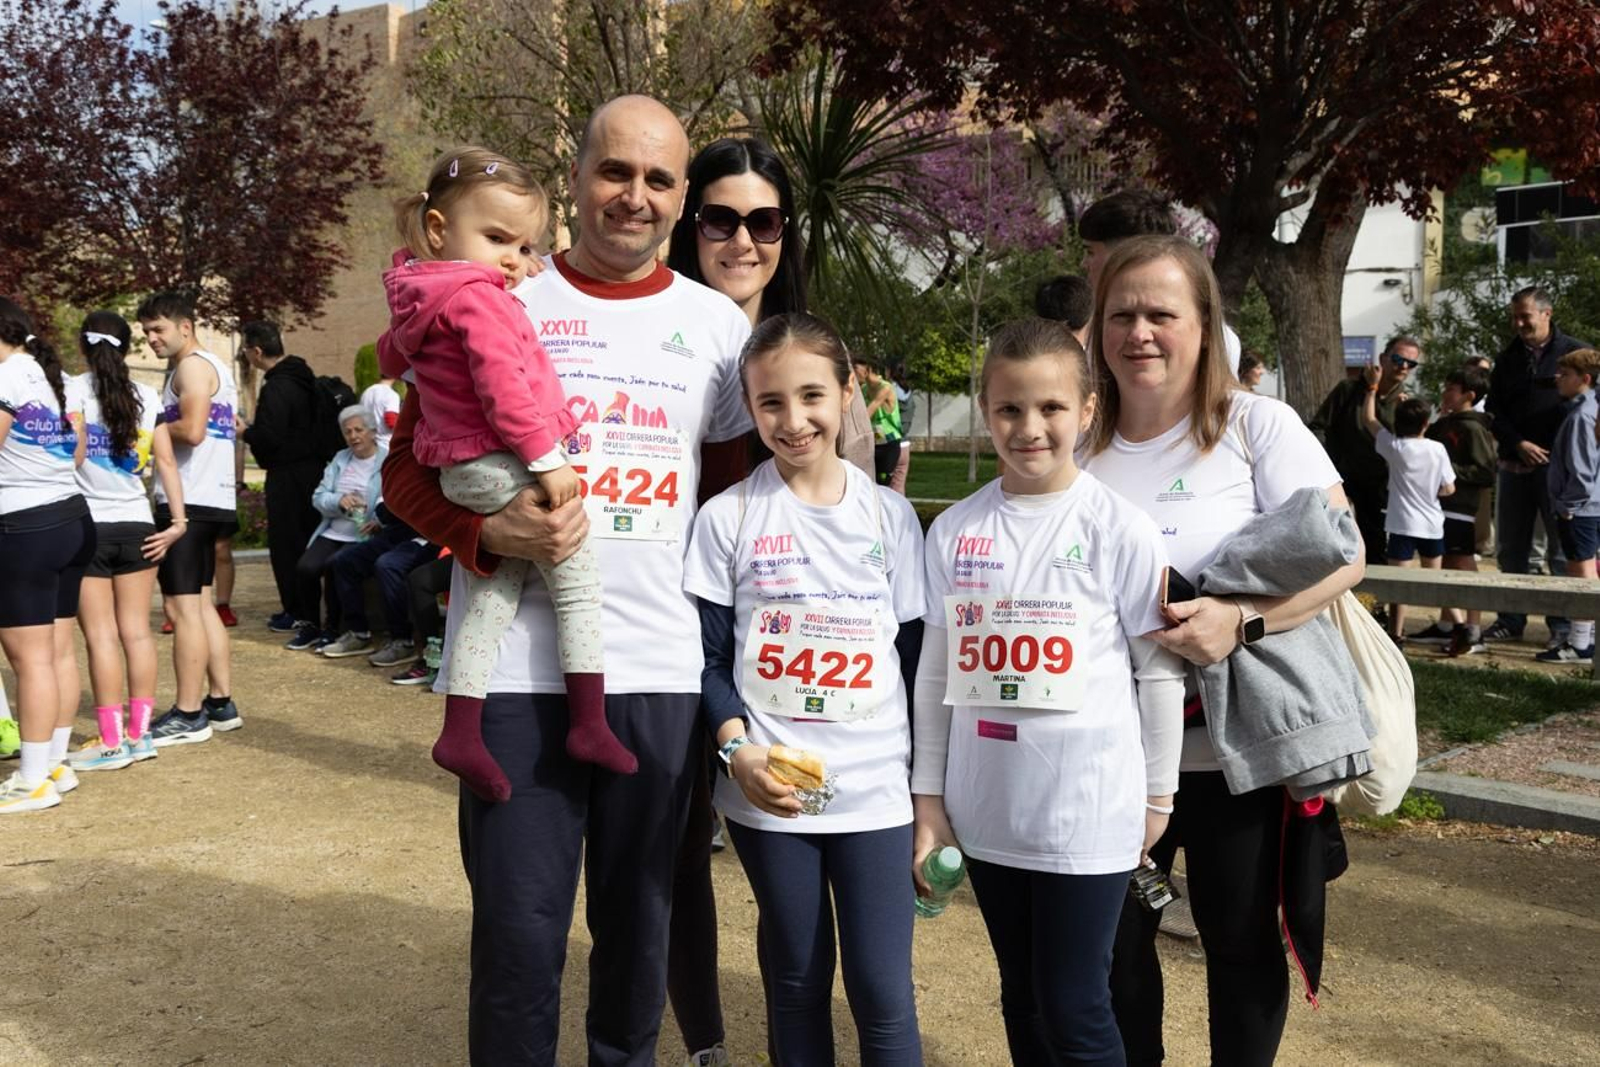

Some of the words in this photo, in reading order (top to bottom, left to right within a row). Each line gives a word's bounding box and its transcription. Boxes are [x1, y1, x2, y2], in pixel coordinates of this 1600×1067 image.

[540, 319, 588, 336] XXVII
[571, 340, 608, 349] POPULAR
[569, 370, 584, 378] cada
[629, 374, 645, 385] Jaén
[671, 383, 687, 393] salud
[24, 419, 53, 432] club
[605, 431, 625, 441] XXVII
[626, 432, 652, 442] CARRERA
[653, 434, 678, 445] POPULAR
[571, 465, 679, 508] 5424
[603, 505, 642, 515] RAFONCHU
[974, 560, 1005, 571] POPULAR
[1013, 600, 1041, 609] CARRERA
[1042, 600, 1073, 610] POPULAR
[804, 612, 825, 624] XXVII
[825, 615, 851, 626] CARRERA
[957, 634, 1074, 675] 5009
[757, 643, 874, 689] 5422
[993, 674, 1026, 683] MARTINA
[822, 689, 829, 697] 4
[101, 748, 123, 759] HOKA
